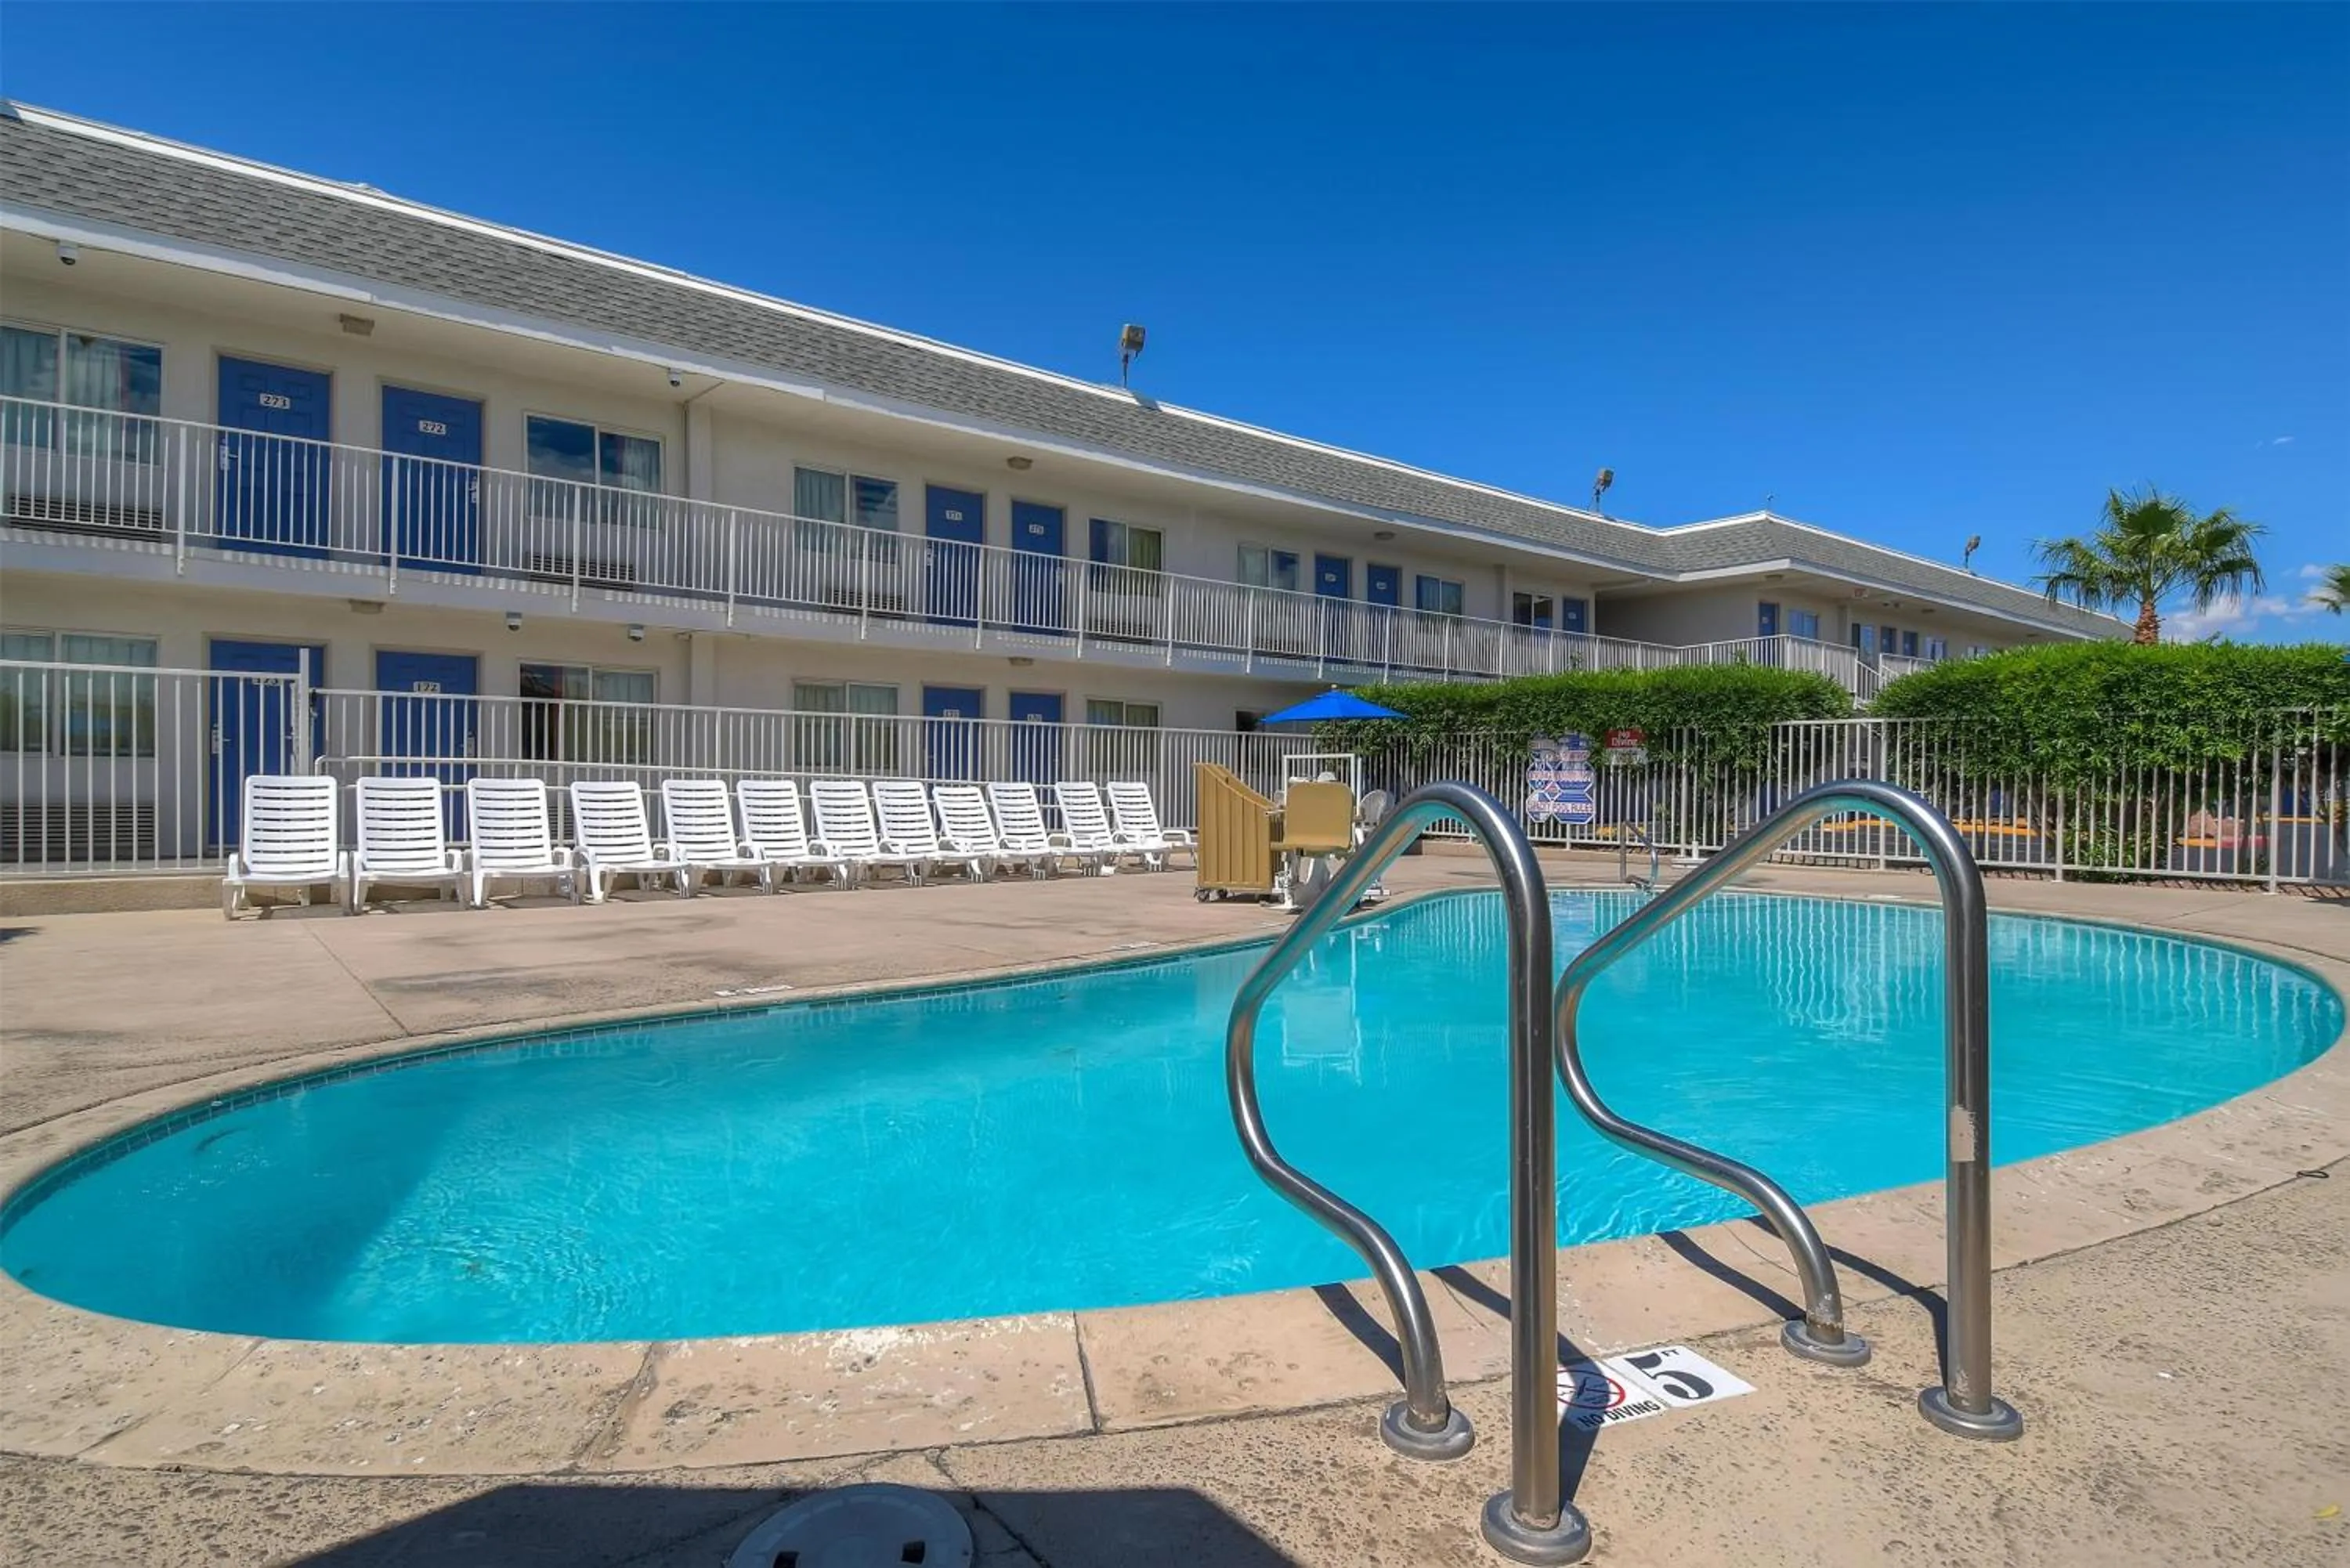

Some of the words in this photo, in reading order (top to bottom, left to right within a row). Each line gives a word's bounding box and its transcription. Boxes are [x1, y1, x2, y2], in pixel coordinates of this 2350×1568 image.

[422, 422, 443, 433] 272
[1661, 1349, 1682, 1357] FT
[1624, 1353, 1715, 1400] 5
[1578, 1413, 1605, 1428] NO
[1606, 1400, 1661, 1422] DIVING
